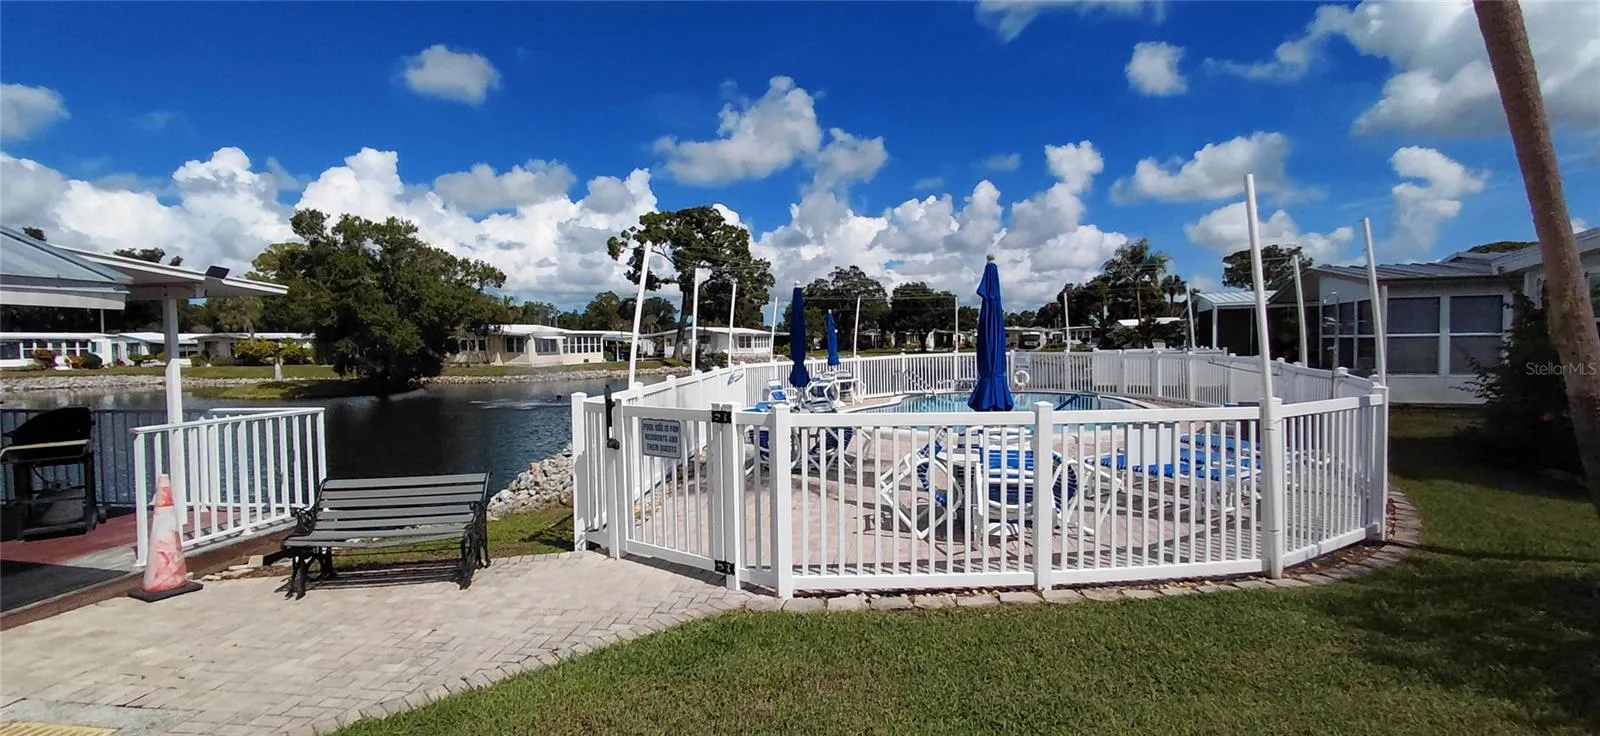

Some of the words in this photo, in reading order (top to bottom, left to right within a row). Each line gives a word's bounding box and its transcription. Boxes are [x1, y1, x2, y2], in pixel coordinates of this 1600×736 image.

[643, 423, 654, 431] POOL
[670, 425, 679, 433] FOR
[645, 433, 668, 442] RESIDENTS
[669, 435, 678, 443] AND
[646, 443, 660, 451] THEIR
[660, 444, 677, 454] GUESTS
